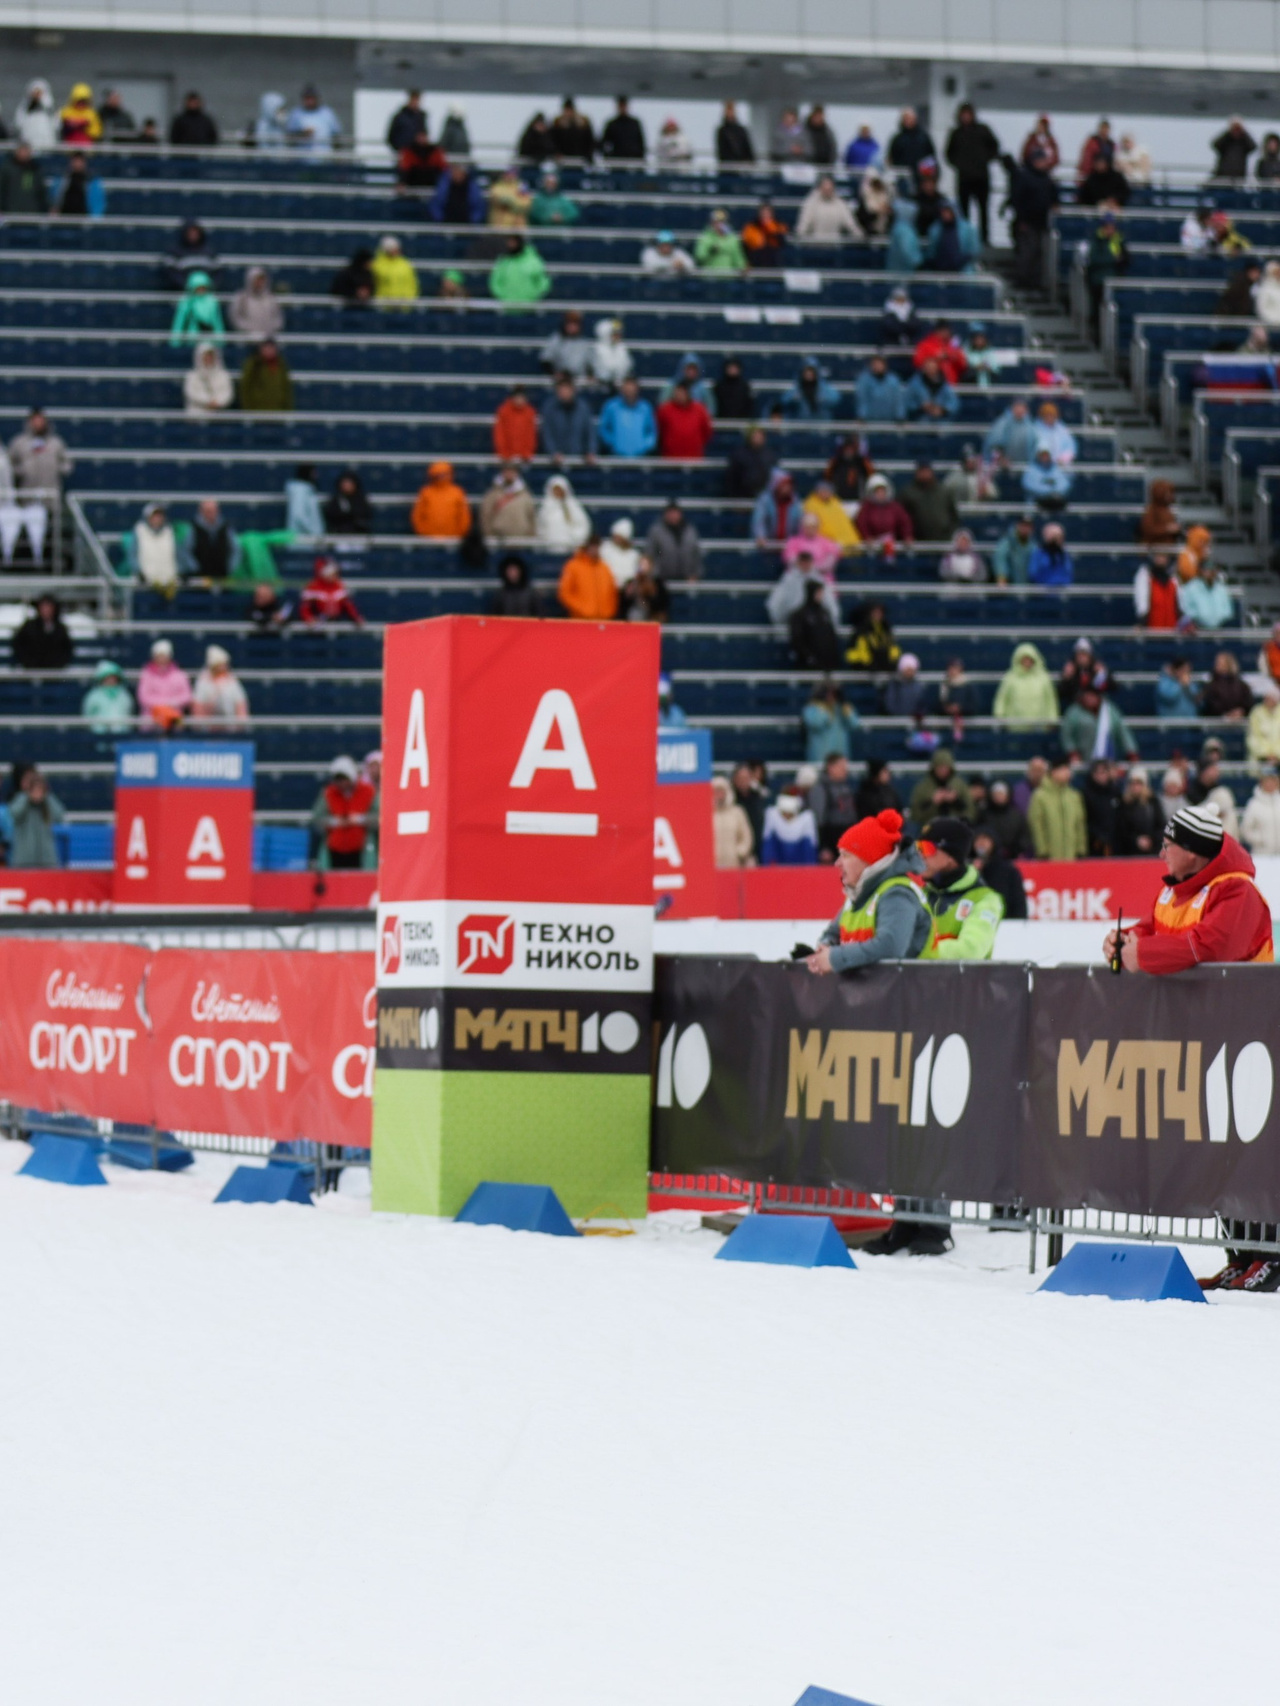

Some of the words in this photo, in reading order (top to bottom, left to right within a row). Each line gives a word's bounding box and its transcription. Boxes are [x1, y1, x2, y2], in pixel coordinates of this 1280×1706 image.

[508, 689, 598, 791] А
[522, 923, 615, 944] ТЕХНО
[525, 950, 640, 971] НИКОЛЬ
[28, 1020, 137, 1076] СПОРТ
[168, 1034, 293, 1092] СПОРТ
